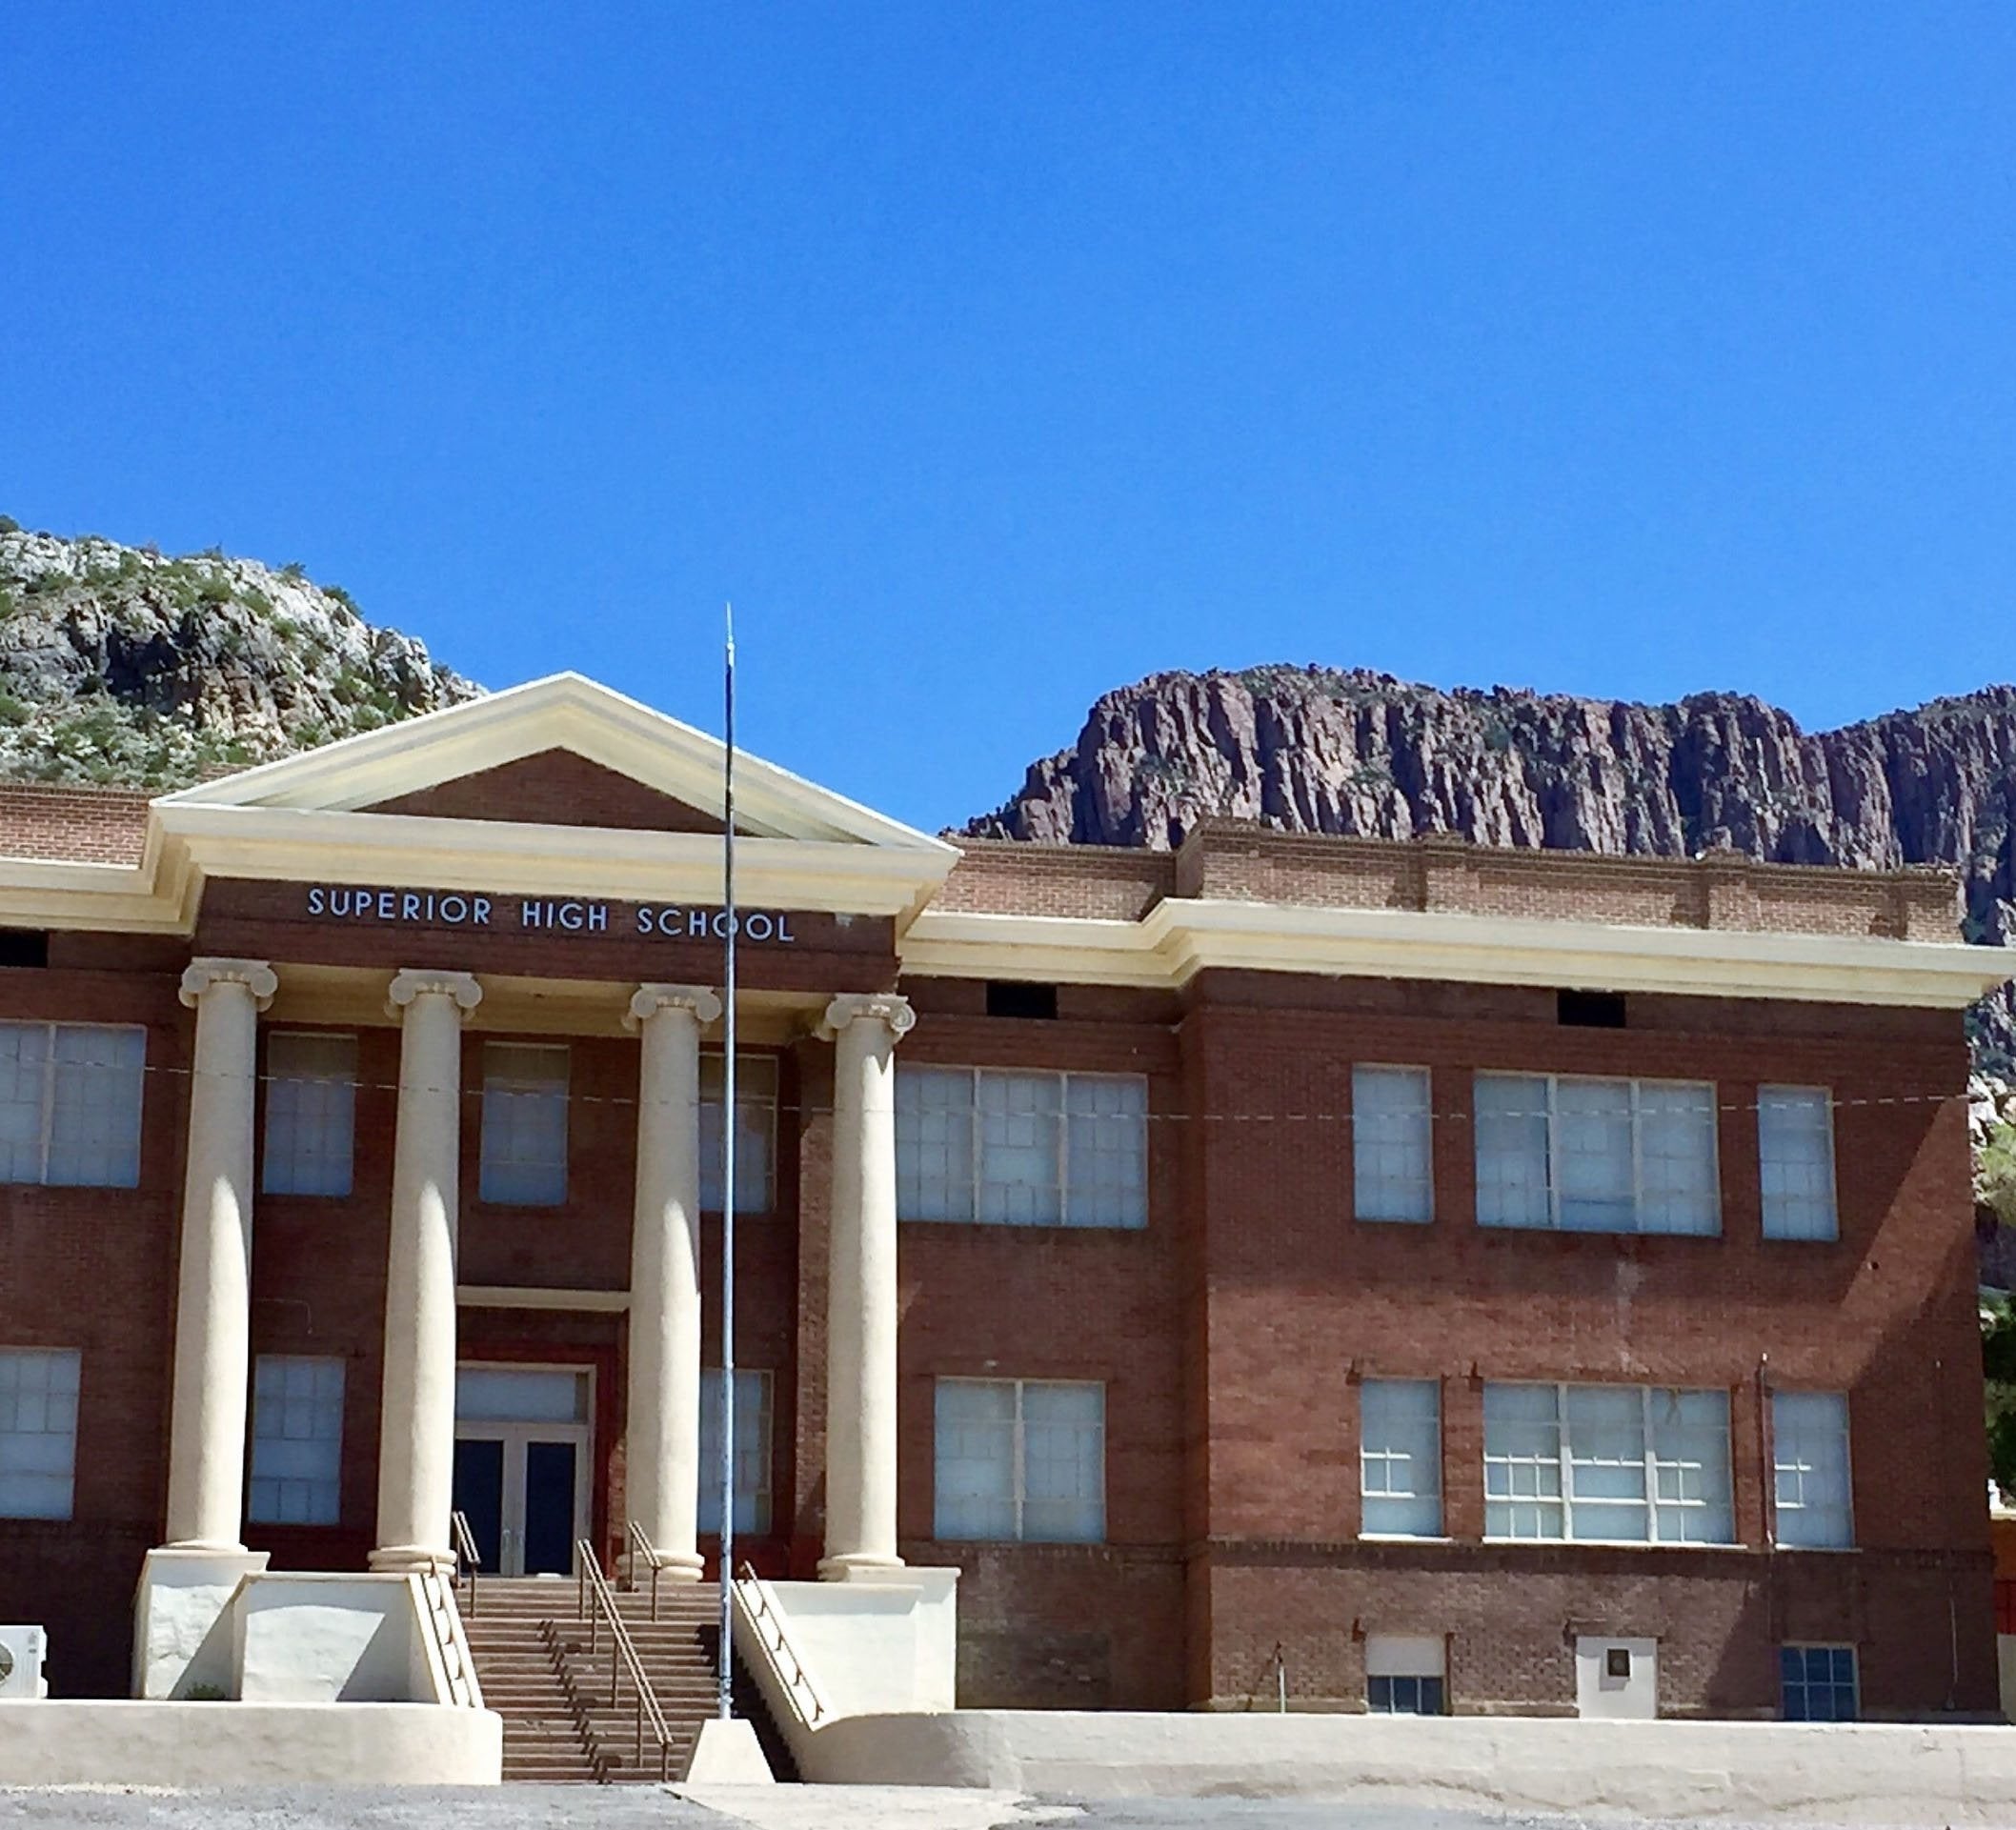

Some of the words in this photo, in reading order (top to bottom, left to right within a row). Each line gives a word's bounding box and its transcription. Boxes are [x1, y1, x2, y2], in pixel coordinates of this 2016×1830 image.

[307, 888, 493, 925] SUPERIOR
[522, 901, 608, 931] HIGH
[636, 907, 795, 942] SCHOOL
